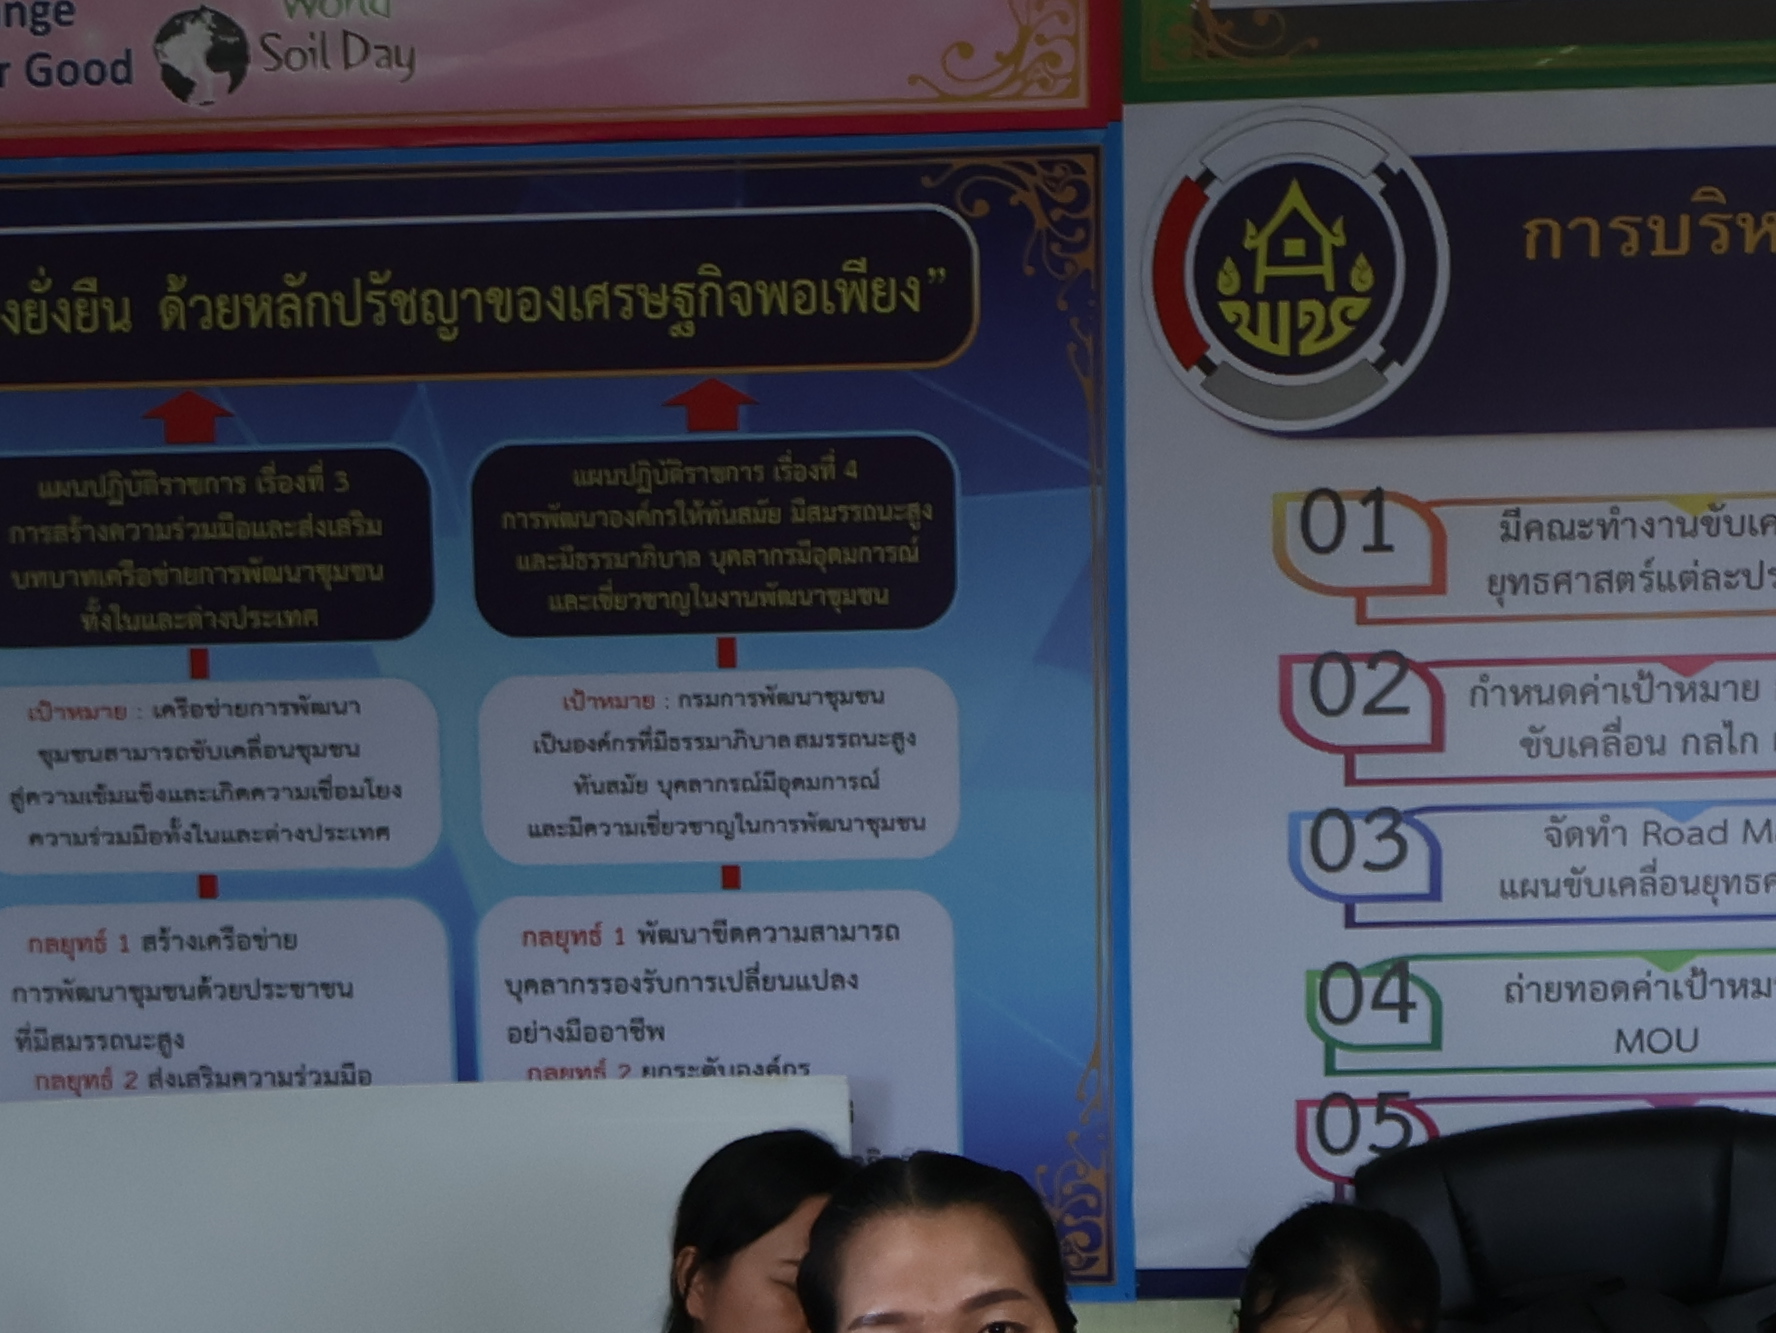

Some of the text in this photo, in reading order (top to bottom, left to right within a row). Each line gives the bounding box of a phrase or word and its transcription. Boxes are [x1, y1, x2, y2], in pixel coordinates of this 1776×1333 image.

[26, 48, 134, 88] Good
[259, 29, 415, 82] Soil Day
[334, 471, 349, 491] 3
[845, 459, 857, 479] 4
[1300, 486, 1395, 555] 01
[1308, 649, 1411, 718] 02
[1469, 673, 1760, 710] กำหนดค่าเป้าหมาย
[1520, 719, 1666, 760] ขับเคลื่อน
[1682, 719, 1759, 757] กลไก
[1308, 806, 1409, 873] 03
[1544, 817, 1627, 849] จัดทำ
[1643, 817, 1729, 848] Road
[28, 928, 108, 961] กลยุทธ์
[522, 922, 603, 953] กลยุทธ์
[1318, 961, 1417, 1026] 04
[1614, 1027, 1699, 1055] MOU
[124, 1073, 138, 1089] 2
[1316, 1091, 1413, 1158] 05
